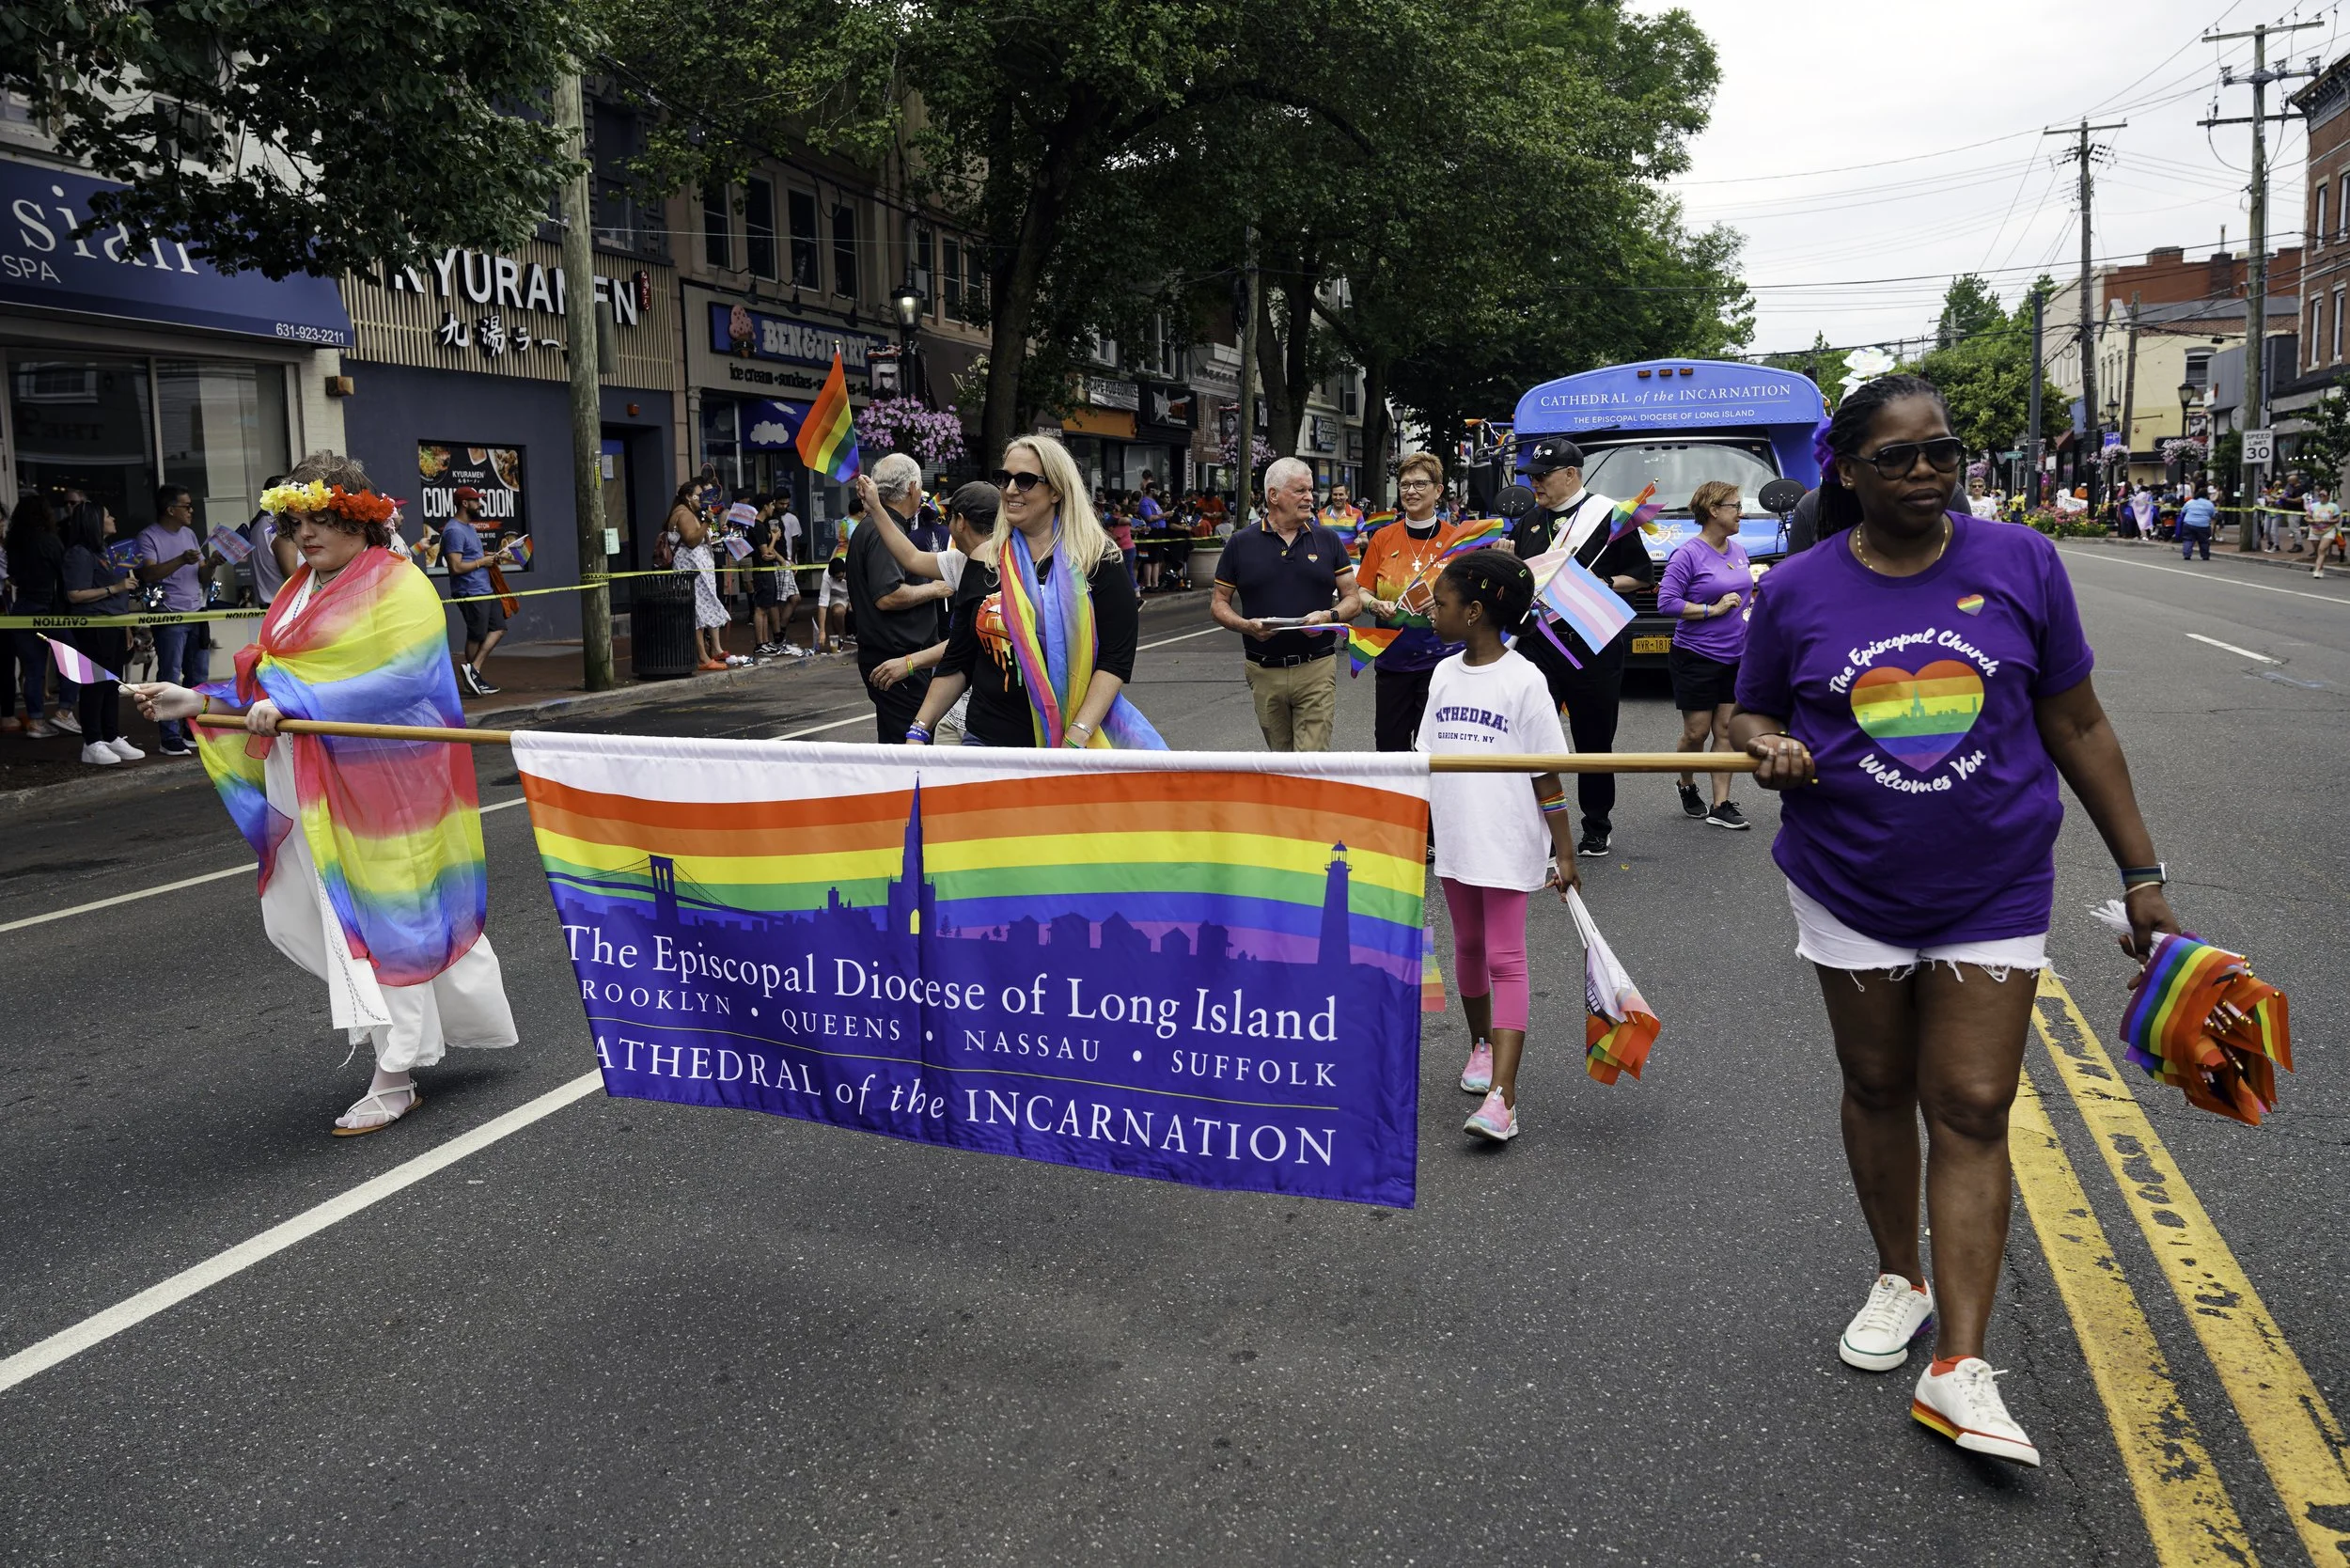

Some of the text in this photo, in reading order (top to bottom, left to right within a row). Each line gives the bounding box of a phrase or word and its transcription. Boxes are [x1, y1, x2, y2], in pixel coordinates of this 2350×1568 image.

[1, 254, 62, 284] SPA
[275, 322, 345, 344] 631-923-2211
[440, 311, 562, 357] 九湯ラー
[761, 320, 878, 368] BEN&JERRY'
[744, 368, 774, 385] cream
[1540, 384, 1792, 407] CATHEDRAL of the INCARNATION
[1591, 415, 1637, 423] EPISCOPAL
[1639, 412, 1678, 422] DIOCESE
[1680, 411, 1692, 421] OF
[1694, 410, 1720, 420] LONG
[1721, 408, 1755, 418] ISLAND
[2246, 432, 2271, 441] SPEED
[2248, 439, 2267, 447] LIMIT
[2246, 447, 2270, 460] 30
[452, 470, 484, 478] KYURAMEN
[33, 617, 88, 627] CAUTION
[138, 614, 183, 625] CAUTION
[1828, 627, 1999, 694] The Episcopal Church
[1435, 706, 1509, 735] ATHEDRA
[1482, 735, 1495, 744] NY
[1858, 749, 1986, 794] Welcomes You
[562, 925, 1339, 1042] The Episcopal Diocese of Long Island
[582, 979, 1337, 1088] ROOKLYN QUEENS NASSAU SUFFOLK
[596, 1035, 1337, 1167] ATHEDRAL of the INCARNATION
